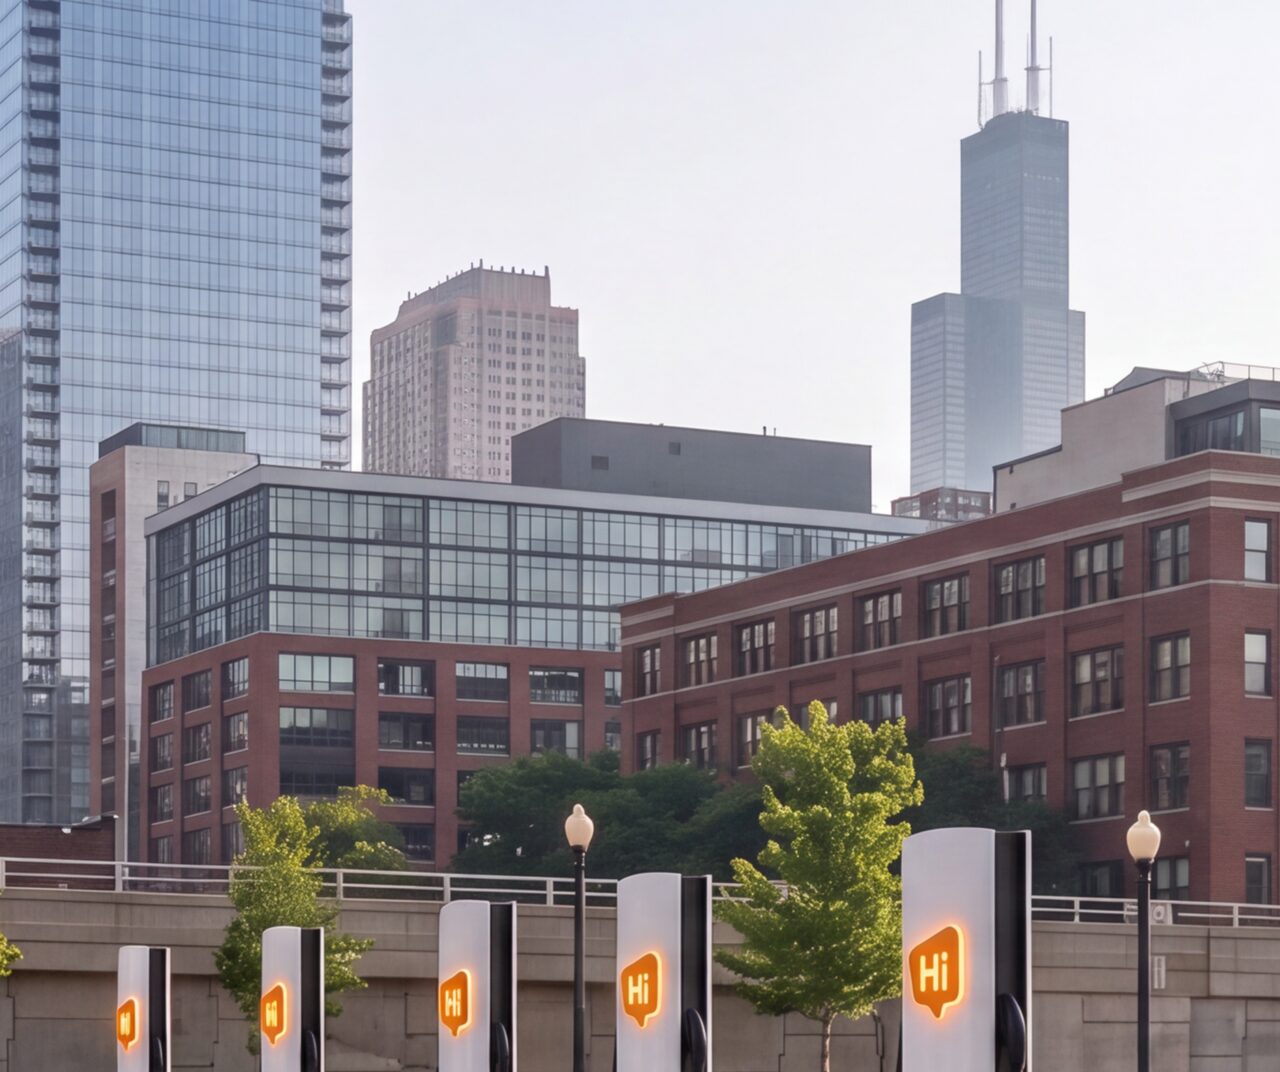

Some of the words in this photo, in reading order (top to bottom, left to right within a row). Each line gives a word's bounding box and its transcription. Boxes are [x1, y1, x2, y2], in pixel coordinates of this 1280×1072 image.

[920, 951, 948, 992] Hi
[445, 989, 461, 1016] Hi
[628, 973, 648, 1005] Hi
